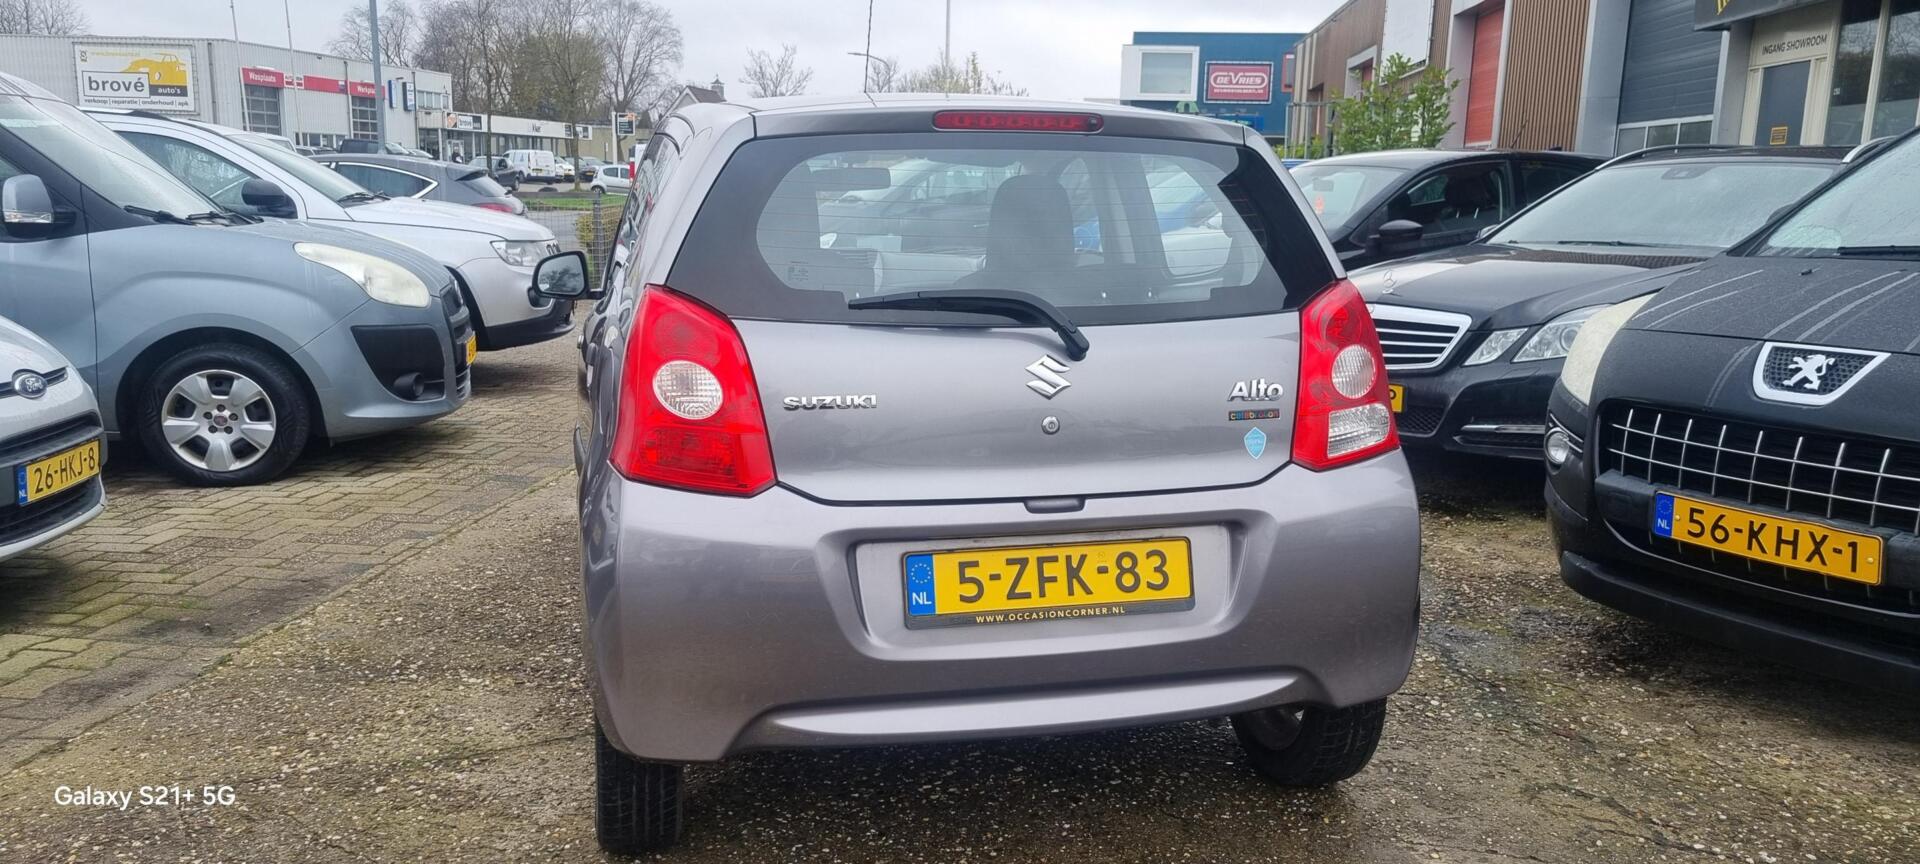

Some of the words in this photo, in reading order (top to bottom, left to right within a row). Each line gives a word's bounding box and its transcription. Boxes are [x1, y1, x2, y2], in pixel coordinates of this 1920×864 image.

[1762, 42, 1785, 55] INGANG
[1786, 35, 1827, 51] SHOWROOM
[88, 75, 145, 92] brové
[248, 72, 276, 83] Wasplaats
[1226, 378, 1284, 401] Alto
[783, 394, 877, 411] SUZUKI
[34, 447, 96, 494] 26-HKJ-8
[1657, 518, 1670, 530] NL
[1687, 507, 1859, 573] 56-KHX-1
[959, 550, 1169, 603] 5-ZFK-83
[912, 592, 932, 605] NL
[976, 605, 1126, 623] WWW.OCCASIONCORNER.NL
